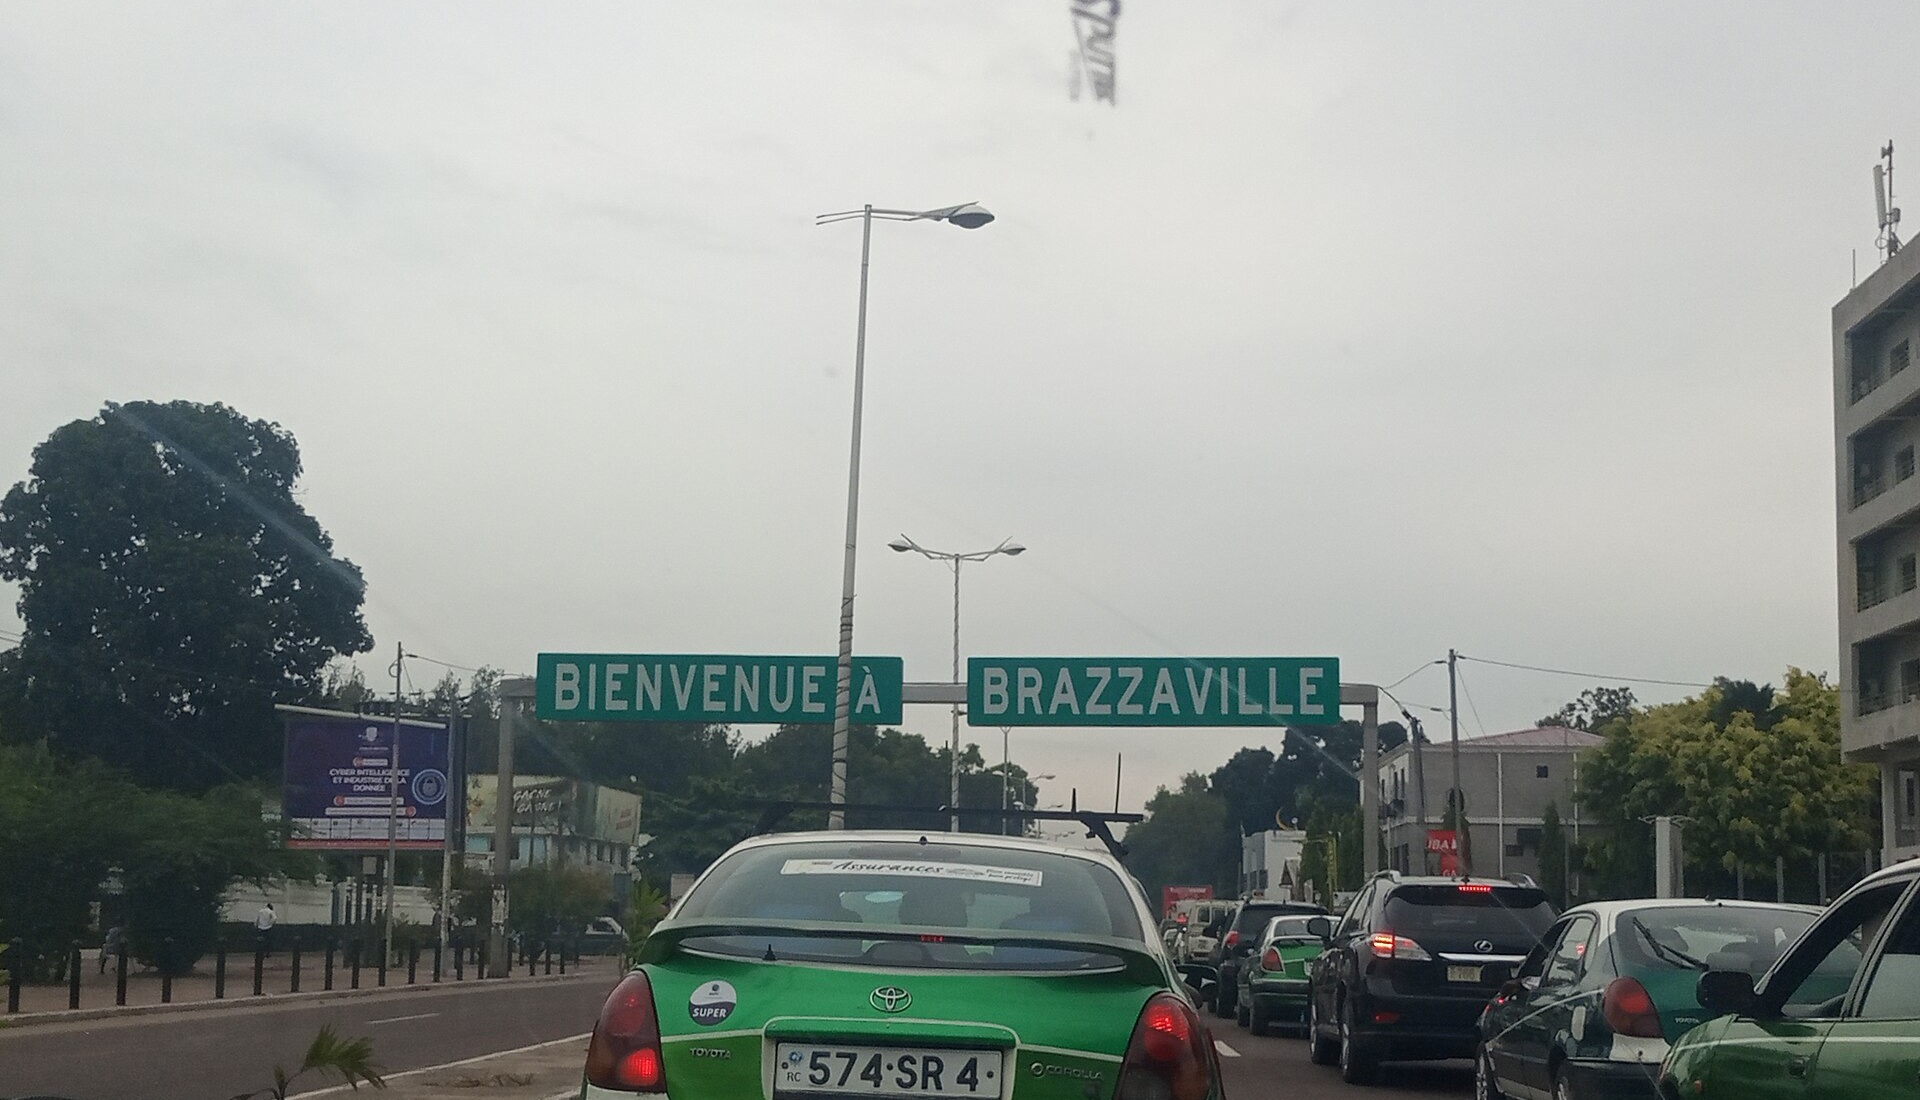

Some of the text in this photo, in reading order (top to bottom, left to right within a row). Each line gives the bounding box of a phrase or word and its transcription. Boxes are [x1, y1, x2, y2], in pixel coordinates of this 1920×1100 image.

[555, 662, 881, 714] BIENVENUE À
[983, 667, 1325, 715] BRAZZAVILLE
[834, 860, 943, 875] Assurances
[692, 1007, 727, 1018] SUPER
[690, 1047, 732, 1059] TOYOTA
[787, 1071, 801, 1083] RC
[1046, 1065, 1104, 1081] COROLLA
